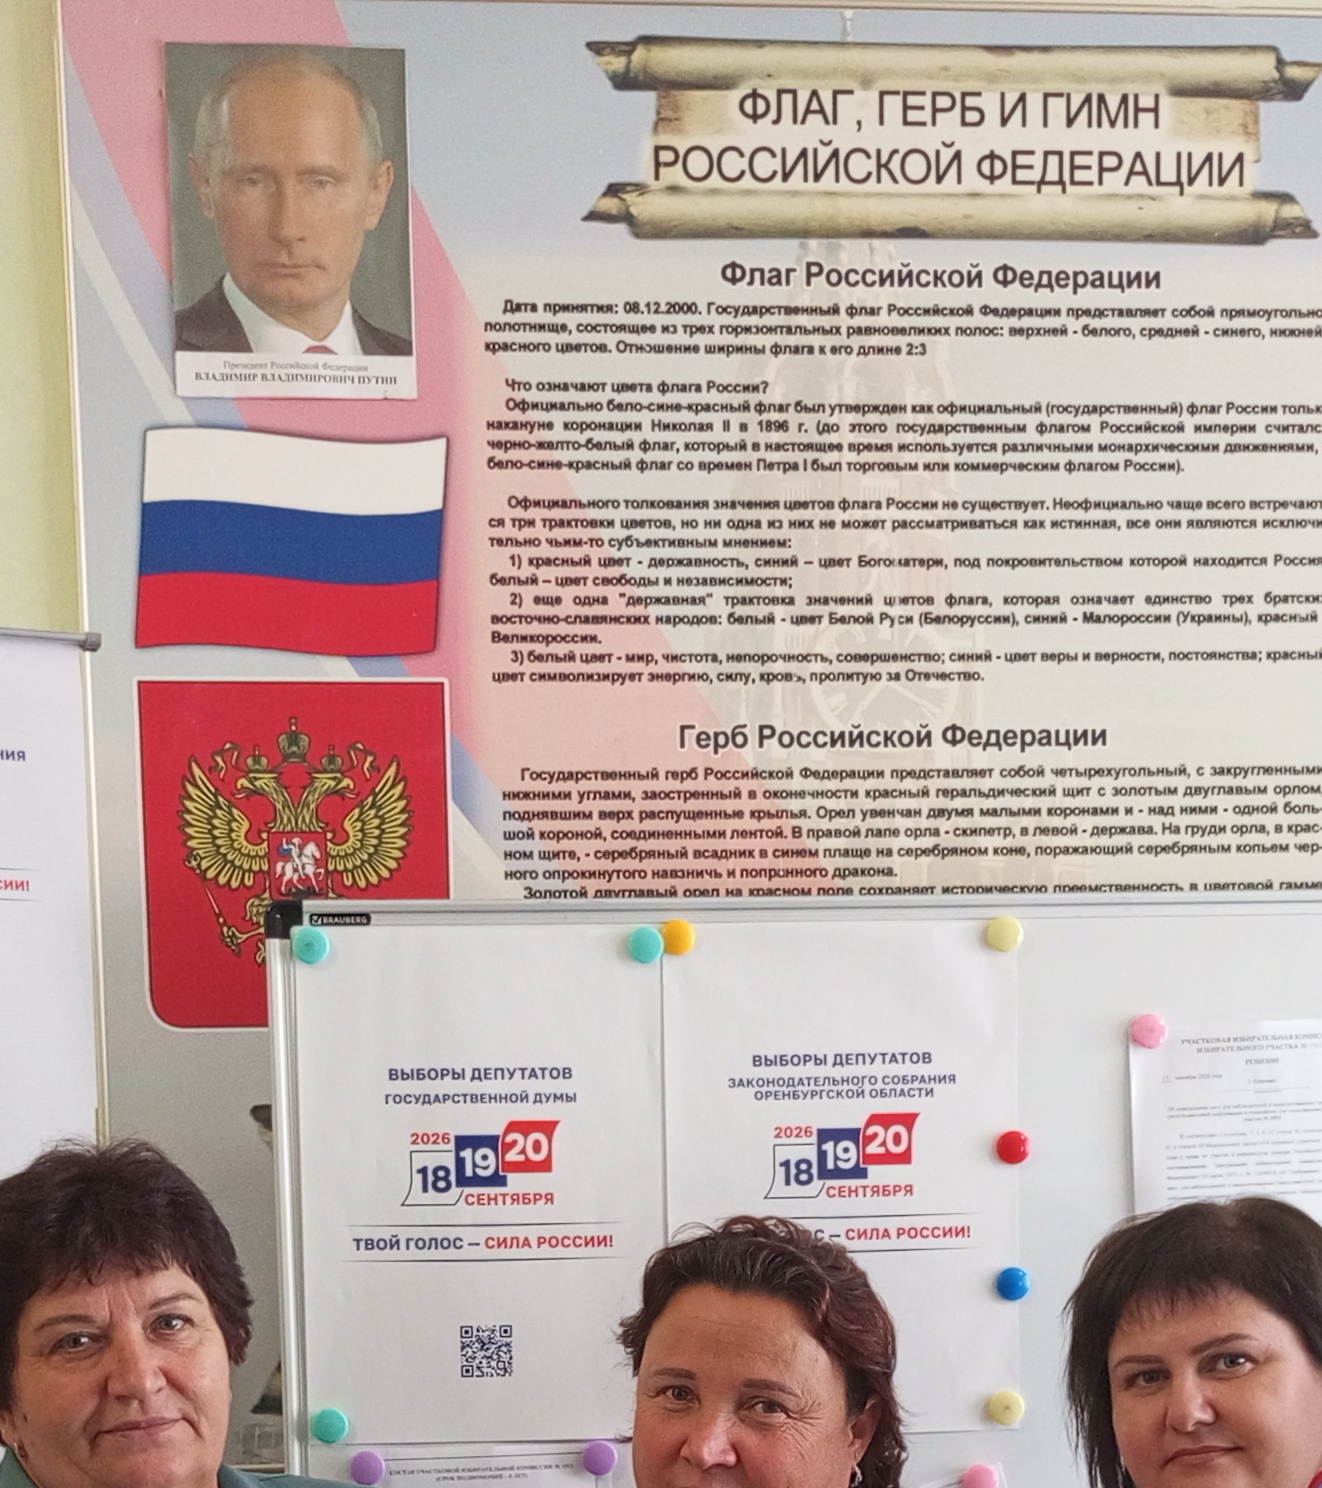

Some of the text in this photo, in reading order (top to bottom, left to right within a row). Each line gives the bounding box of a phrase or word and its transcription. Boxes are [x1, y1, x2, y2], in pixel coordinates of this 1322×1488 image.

[738, 87, 1160, 133] ФЛАГ, ГЕРБ И ГИМН
[653, 139, 1245, 195] РОССИЙСКОЙ ФЕДЕРАЦИИ
[720, 260, 1161, 296] Флаг Российской Федерации
[194, 372, 397, 385] ВЛАДИМИР ВЛАДИМИРОВИЧ ПУТИН
[504, 378, 769, 397] Что означают цвета флага России?
[505, 397, 604, 415] Официально
[606, 398, 751, 416] бело-сине-красный
[753, 400, 792, 417] флаг
[793, 399, 826, 414] был
[828, 403, 908, 418] утвержден
[910, 404, 934, 415] как
[936, 401, 1043, 418] официальный
[1045, 401, 1184, 418] (государственный)
[1185, 402, 1223, 418] флаг
[1225, 401, 1278, 415] России
[679, 723, 1107, 754] Герб Российской Федерации
[752, 1051, 933, 1068] ВЫБОРЫ ДЕПУТАТОВ
[388, 1066, 573, 1083] ВЫБОРЫ ДЕПУТАТОВ
[727, 1073, 956, 1089] ЗАКОНОДАТЕЛЬНОГО СОБРАНИЯ
[384, 1090, 577, 1106] ГОСУДАРСТВЕННОЙ ДУМЫ
[754, 1087, 934, 1101] ОРЕНБУРГСКОЙ ОБЛАСТИ
[410, 1132, 450, 1146] 2026
[773, 1125, 813, 1138] 2026
[416, 1132, 549, 1194] 18 19 20
[779, 1124, 909, 1187] 18 19 20
[464, 1192, 555, 1206] СЕНТЯБРЯ
[826, 1184, 914, 1199] СЕНТЯБРЯ
[844, 1227, 892, 1241] СИЛА
[896, 1225, 971, 1240] РОССИИ!
[352, 1234, 401, 1251] ТВОЙ
[405, 1236, 464, 1251] ГОЛОС
[484, 1236, 533, 1250] СИЛА
[536, 1234, 614, 1249] РОССИИ!
